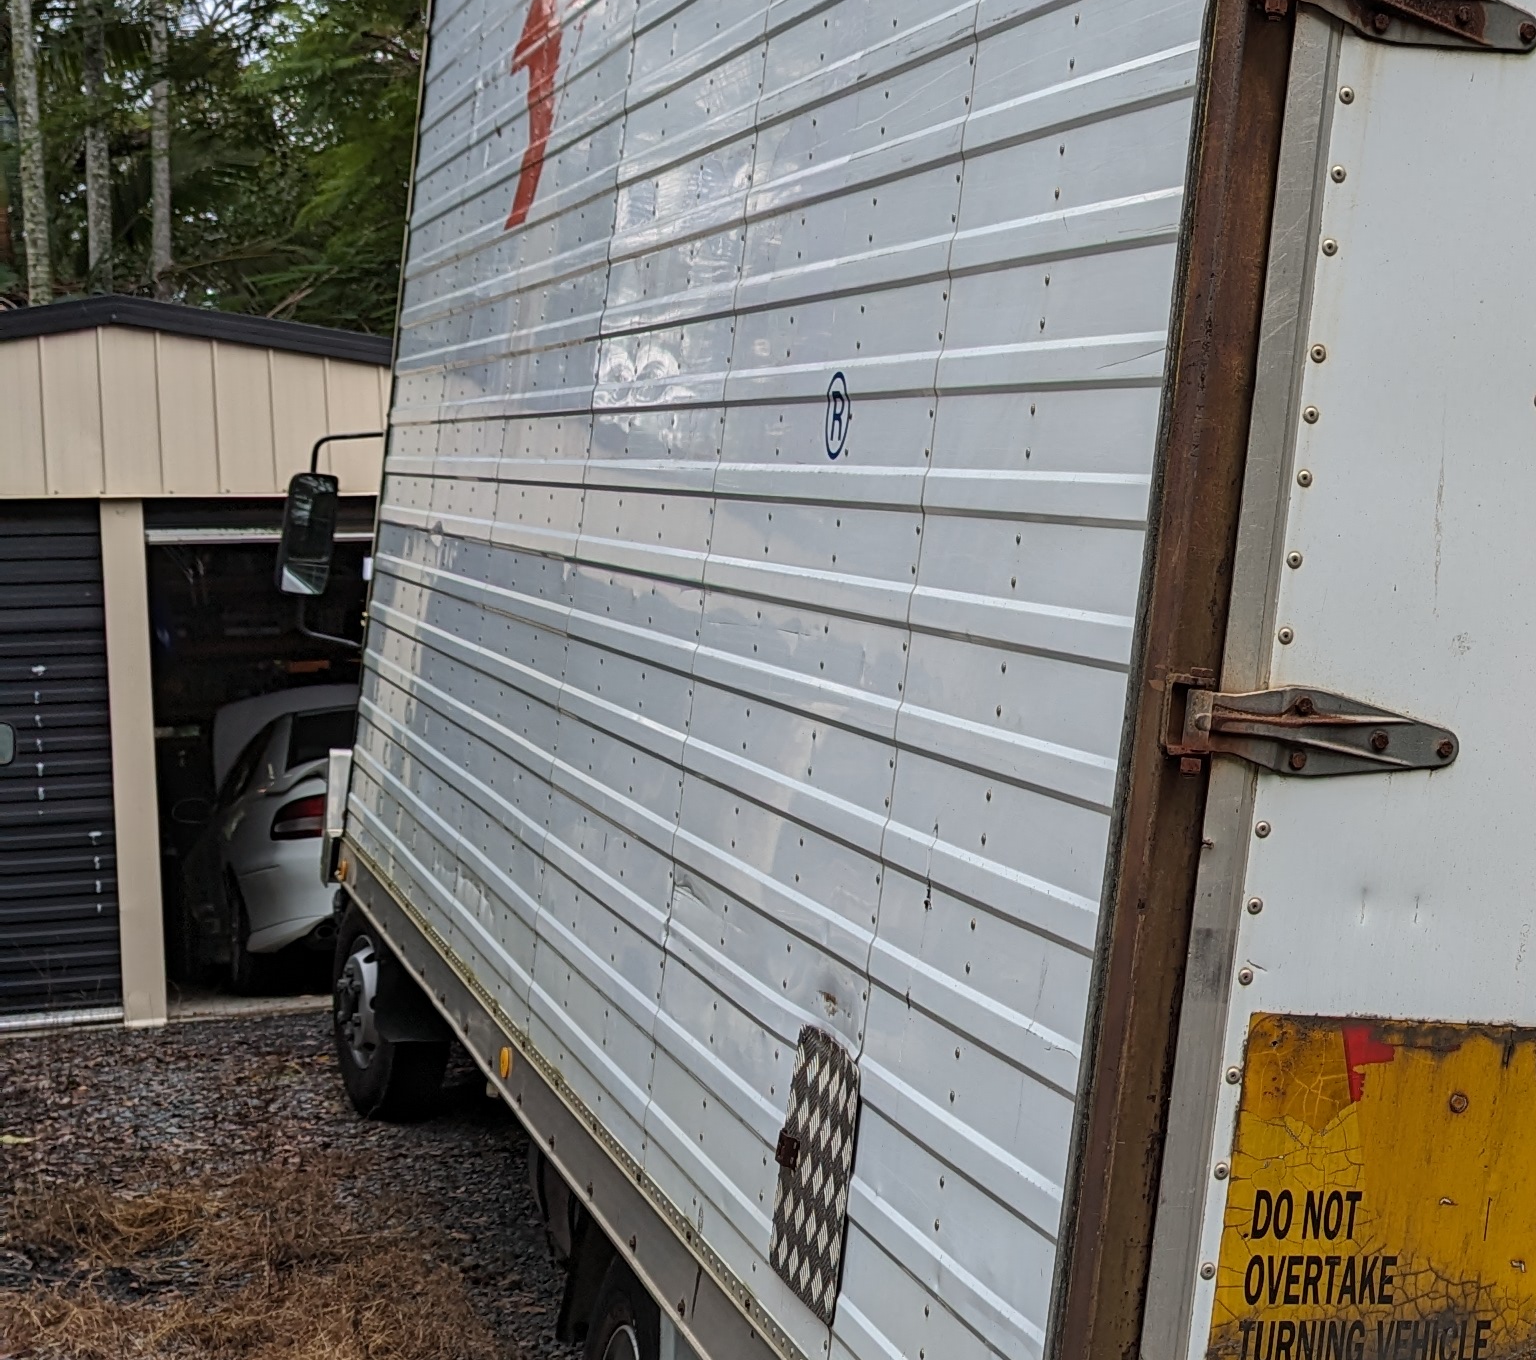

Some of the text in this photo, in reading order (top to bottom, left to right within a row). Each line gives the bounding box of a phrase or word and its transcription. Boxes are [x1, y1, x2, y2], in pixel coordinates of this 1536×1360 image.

[1251, 1189, 1363, 1240] DO NOT
[1244, 1254, 1398, 1305] OVERTAKE
